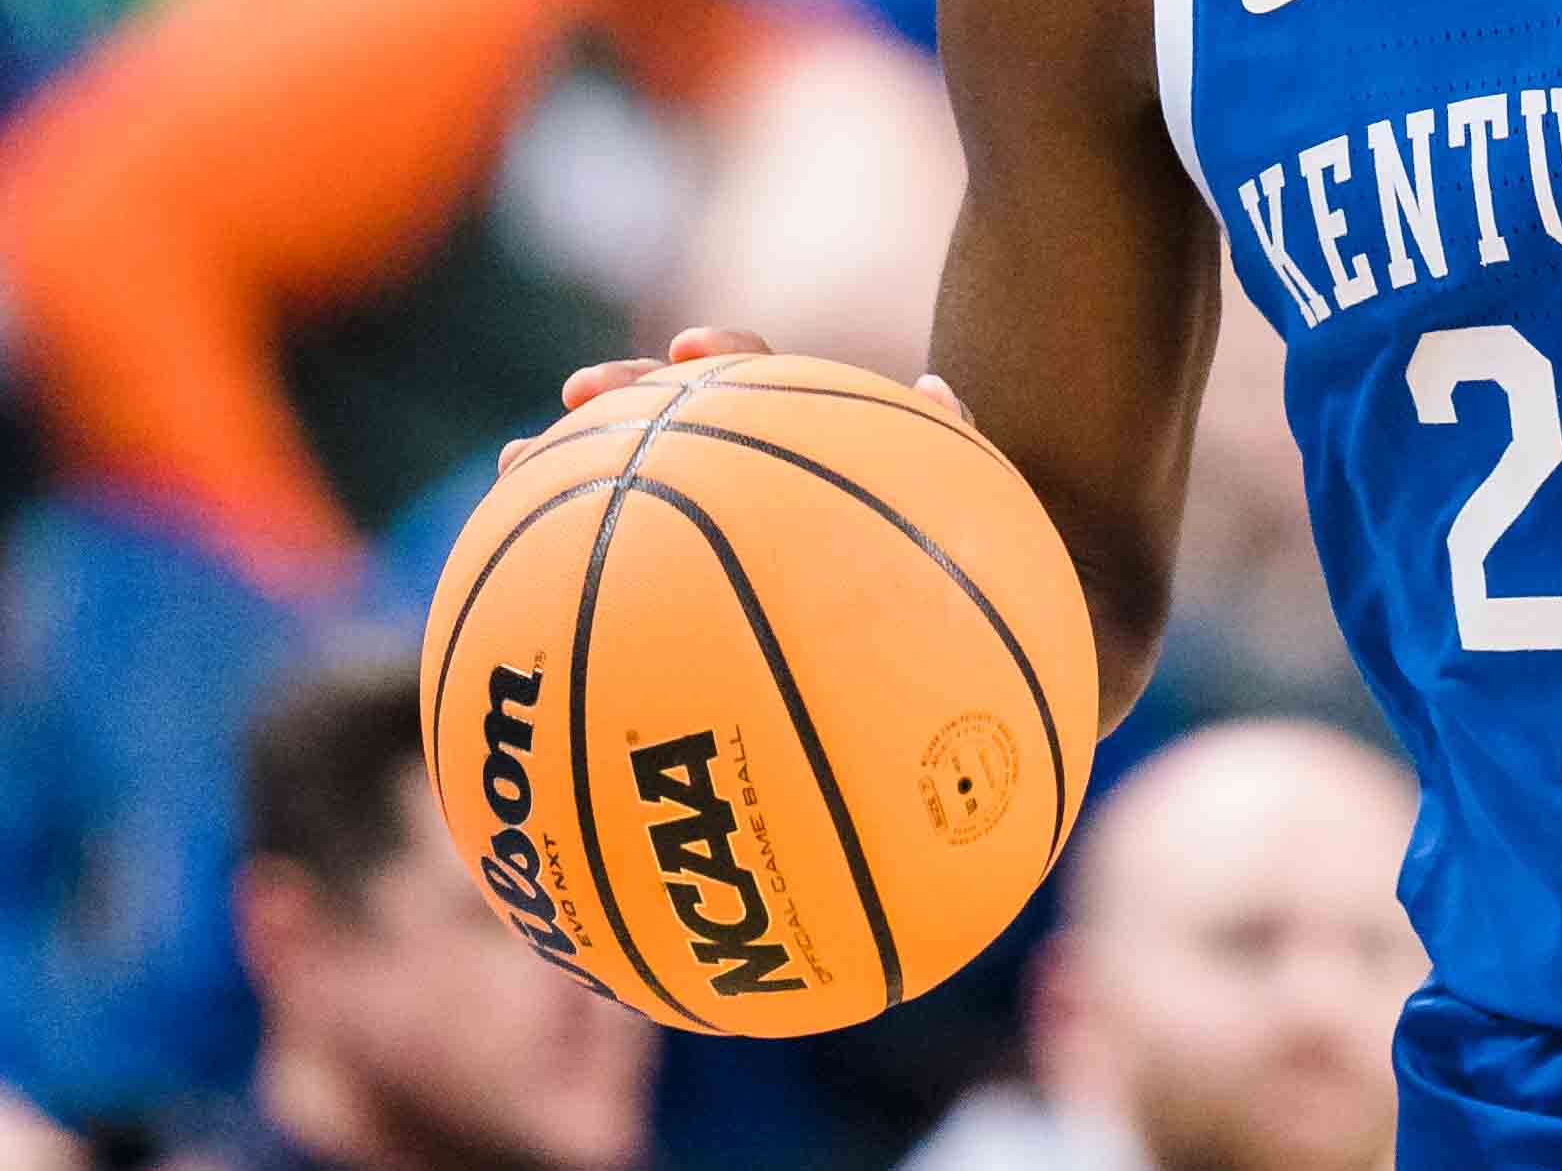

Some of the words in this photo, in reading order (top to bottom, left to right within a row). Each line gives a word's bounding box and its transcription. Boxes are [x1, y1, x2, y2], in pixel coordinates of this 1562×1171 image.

[729, 724, 758, 806] BALL
[543, 832, 568, 891] NXT
[629, 729, 809, 996] NCAA
[750, 812, 787, 893] GAME
[560, 899, 593, 948] EVO
